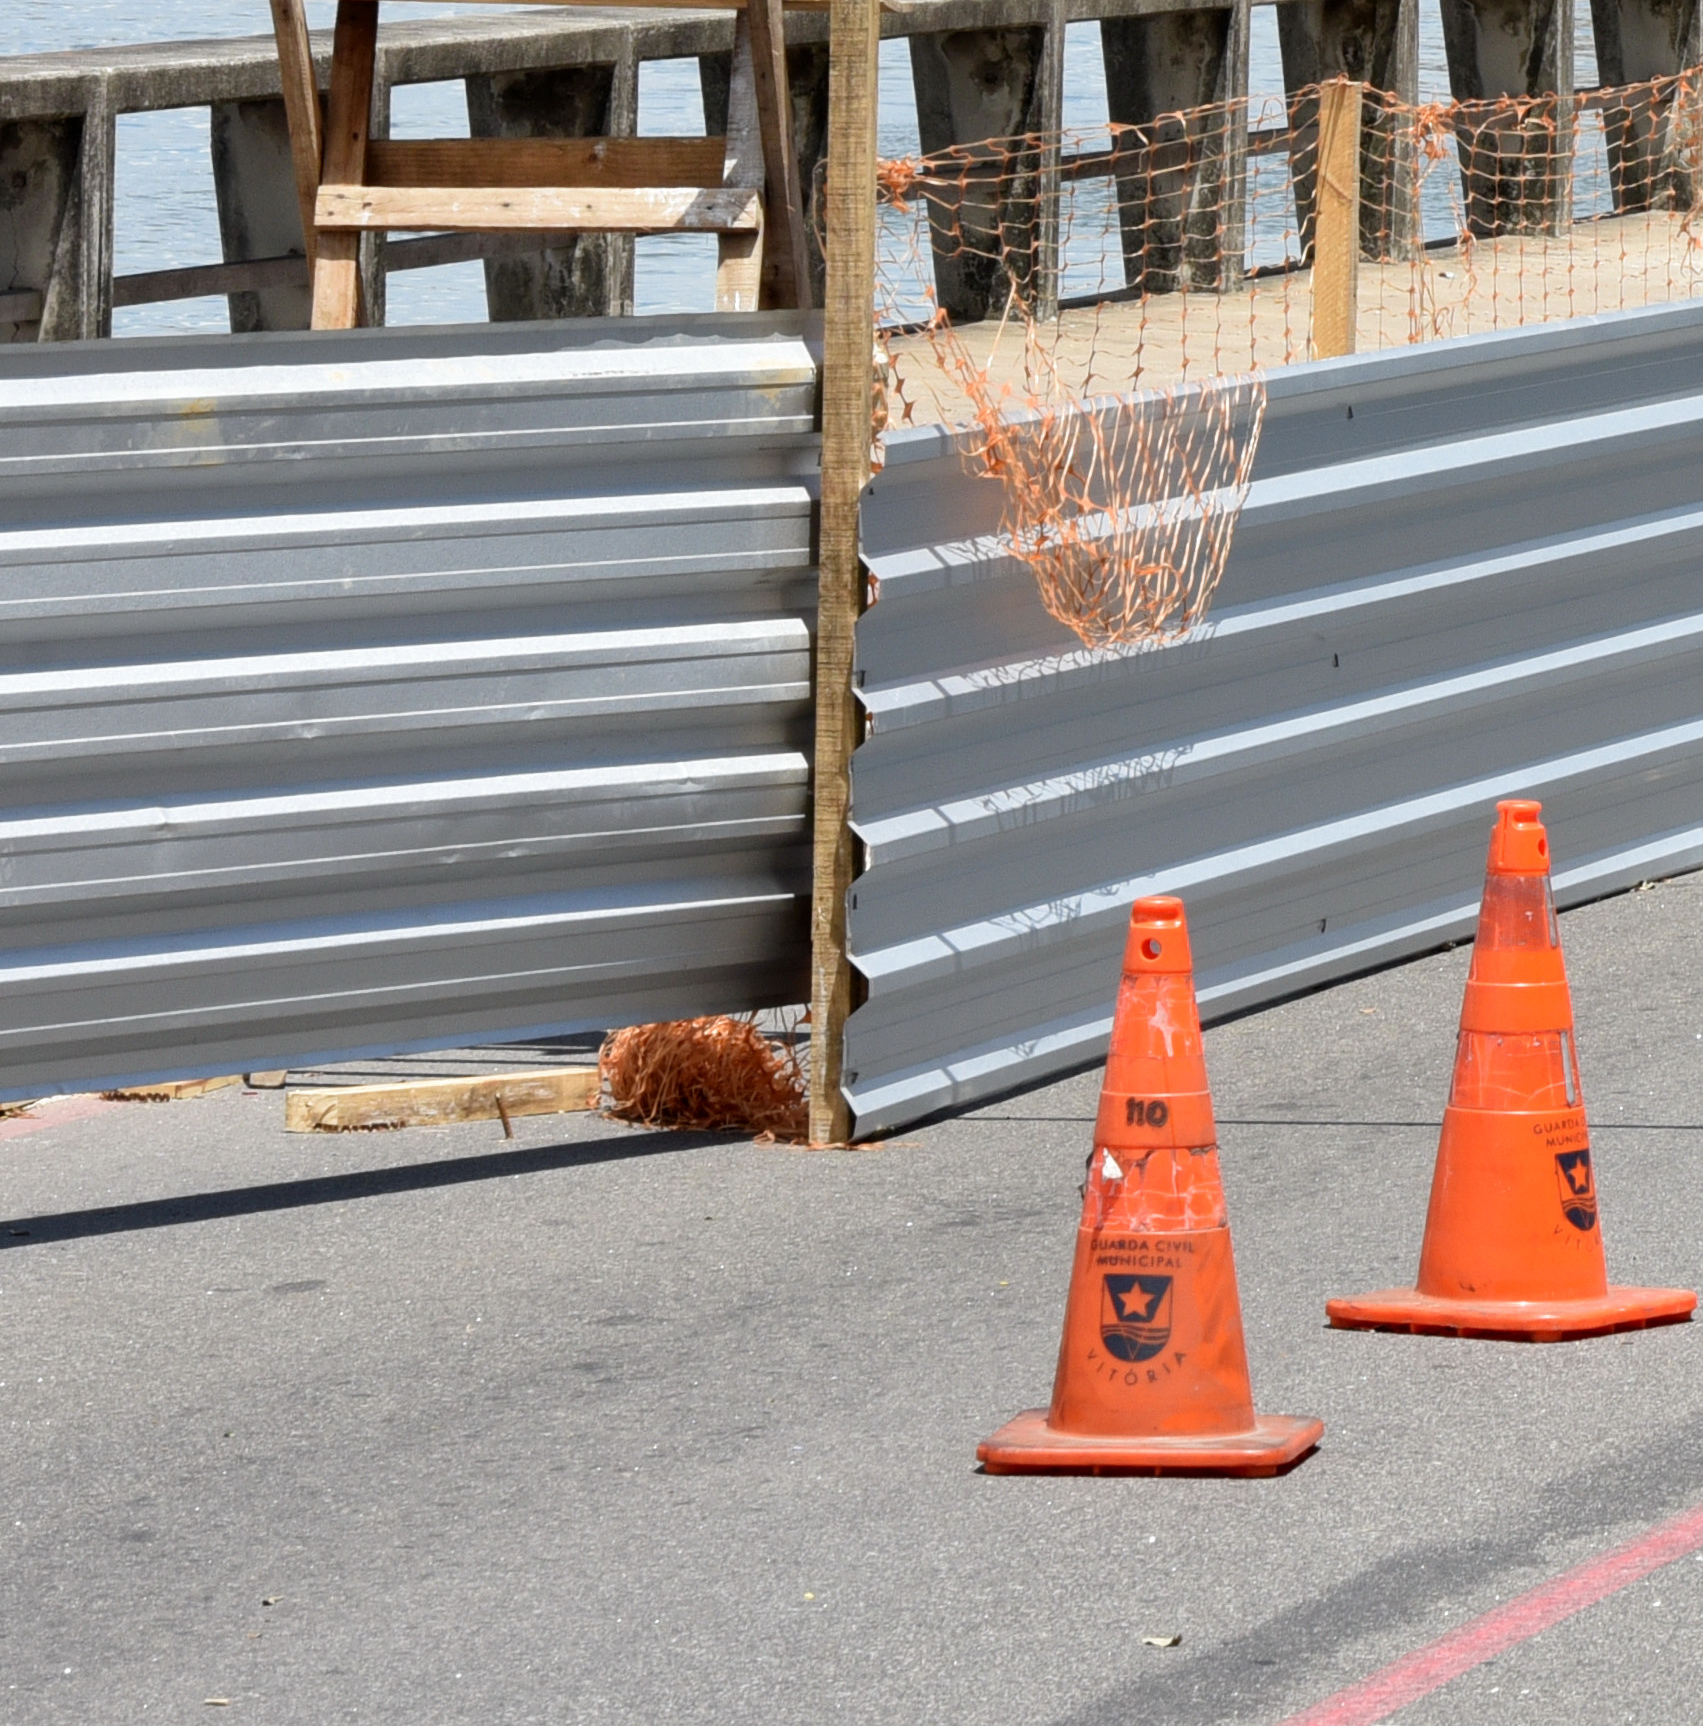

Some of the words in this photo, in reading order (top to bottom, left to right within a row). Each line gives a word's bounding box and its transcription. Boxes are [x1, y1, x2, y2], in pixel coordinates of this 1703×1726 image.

[1533, 1117, 1580, 1135] GUARDA
[1091, 1239, 1149, 1251] GUARDA
[1155, 1240, 1195, 1254] CIVIL
[1097, 1255, 1182, 1268] MUNICIPAL
[1087, 1348, 1187, 1386] VITÓRIA
